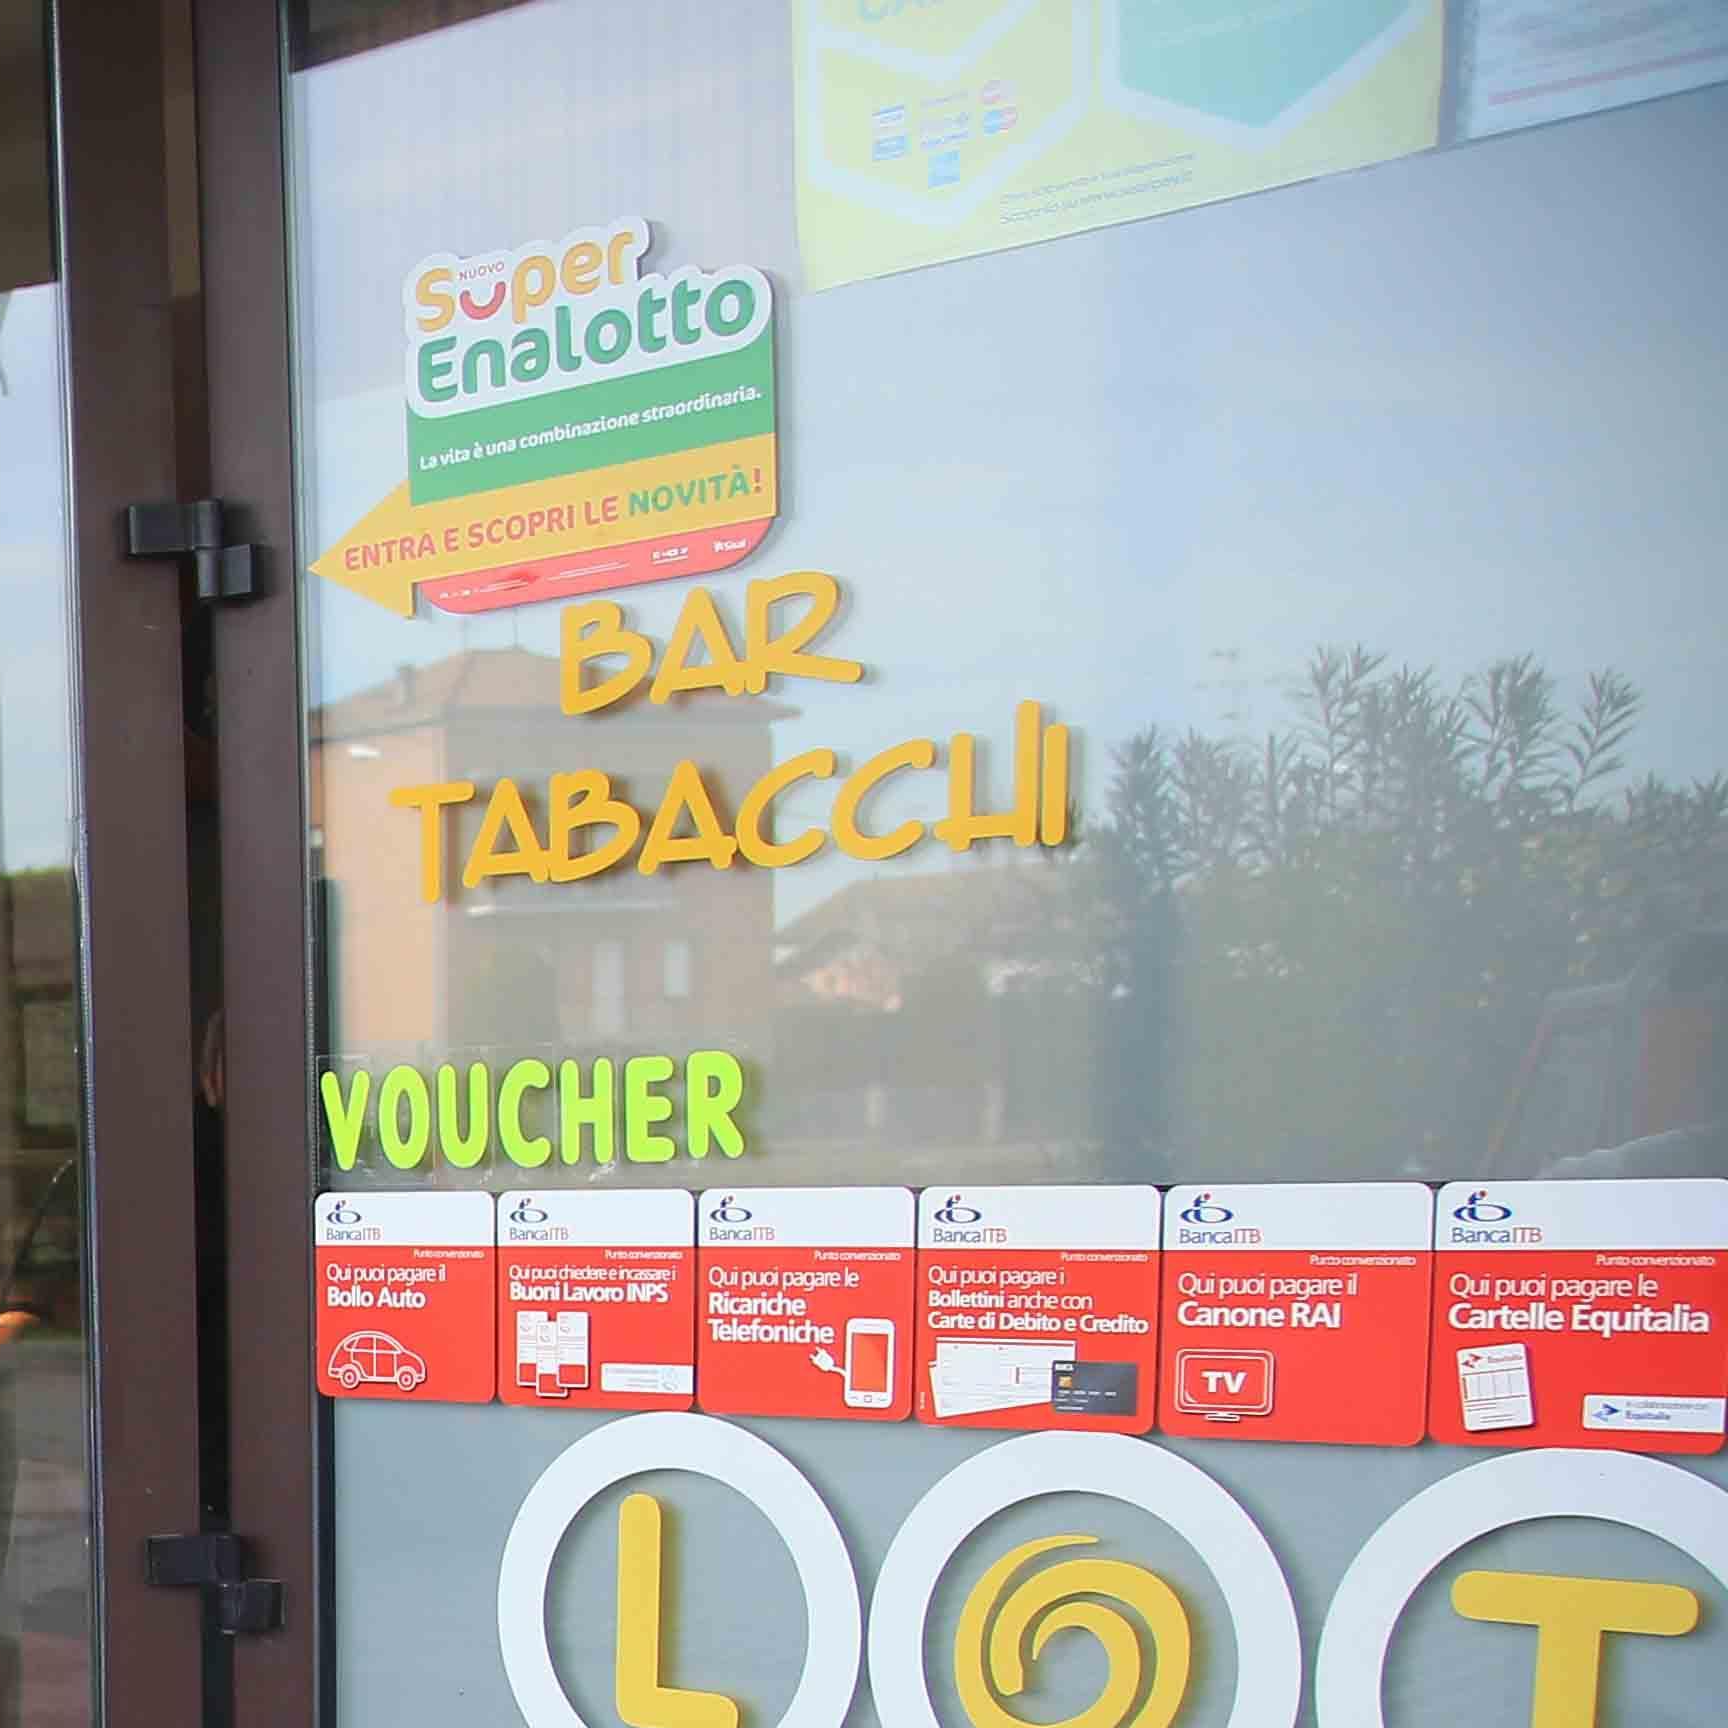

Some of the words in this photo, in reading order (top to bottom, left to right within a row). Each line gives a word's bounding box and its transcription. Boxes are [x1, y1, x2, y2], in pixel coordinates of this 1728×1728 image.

[415, 230, 635, 332] Super
[418, 278, 756, 402] Enalotto
[419, 454, 437, 470] La
[439, 447, 471, 465] vita
[486, 439, 516, 455] una
[520, 410, 639, 449] combinazione
[642, 386, 762, 424] straordinaria.
[345, 532, 436, 571] ENTRA
[444, 528, 459, 552] E
[468, 507, 575, 549] SCOPRI
[584, 496, 619, 526] LE
[559, 571, 865, 716] BAR
[387, 699, 1070, 903] TABACCHI
[321, 1050, 745, 1171] VOUCHER
[326, 1263, 351, 1284] Qui
[354, 1264, 385, 1286] puoi
[387, 1268, 437, 1287] pagare
[438, 1264, 446, 1281] il
[509, 1265, 530, 1281] Qui
[532, 1265, 557, 1283] puoi
[559, 1265, 607, 1281] chiedere
[609, 1269, 616, 1280] e
[618, 1266, 671, 1281] incassare
[709, 1266, 738, 1288] Qui
[741, 1267, 778, 1290] puoi
[782, 1272, 841, 1292] pagare
[844, 1267, 859, 1287] le
[928, 1265, 957, 1286] Qui
[960, 1266, 996, 1288] puoi
[1000, 1271, 1057, 1289] pagare
[1178, 1272, 1215, 1297] Qui
[1219, 1273, 1264, 1299] puoi
[1269, 1279, 1343, 1300] pagare
[1347, 1273, 1358, 1295] il
[1449, 1272, 1490, 1299] Qui
[1495, 1273, 1546, 1301] puoi
[1551, 1278, 1632, 1303] pagare
[1638, 1273, 1658, 1297] le
[327, 1285, 374, 1307] Bollo
[377, 1286, 426, 1308] Auto
[510, 1281, 560, 1301] Buoni
[563, 1282, 624, 1301] Lavoro
[627, 1283, 669, 1303] INPS
[709, 1292, 806, 1315] Ricariche
[928, 1290, 1004, 1308] Bollettini
[1007, 1292, 1057, 1309] anche
[1061, 1296, 1093, 1310] con
[928, 1313, 975, 1329] Carte
[978, 1312, 995, 1329] di
[999, 1314, 1060, 1331] Debito
[1064, 1319, 1077, 1331] e
[1080, 1315, 1148, 1334] Credito
[1177, 1301, 1285, 1327] Canone
[1291, 1302, 1341, 1328] RAI
[1448, 1302, 1564, 1330] Cartelle
[1571, 1303, 1709, 1338] Equitalia
[707, 1317, 834, 1344] Telefoniche
[1201, 1371, 1248, 1393] TV
